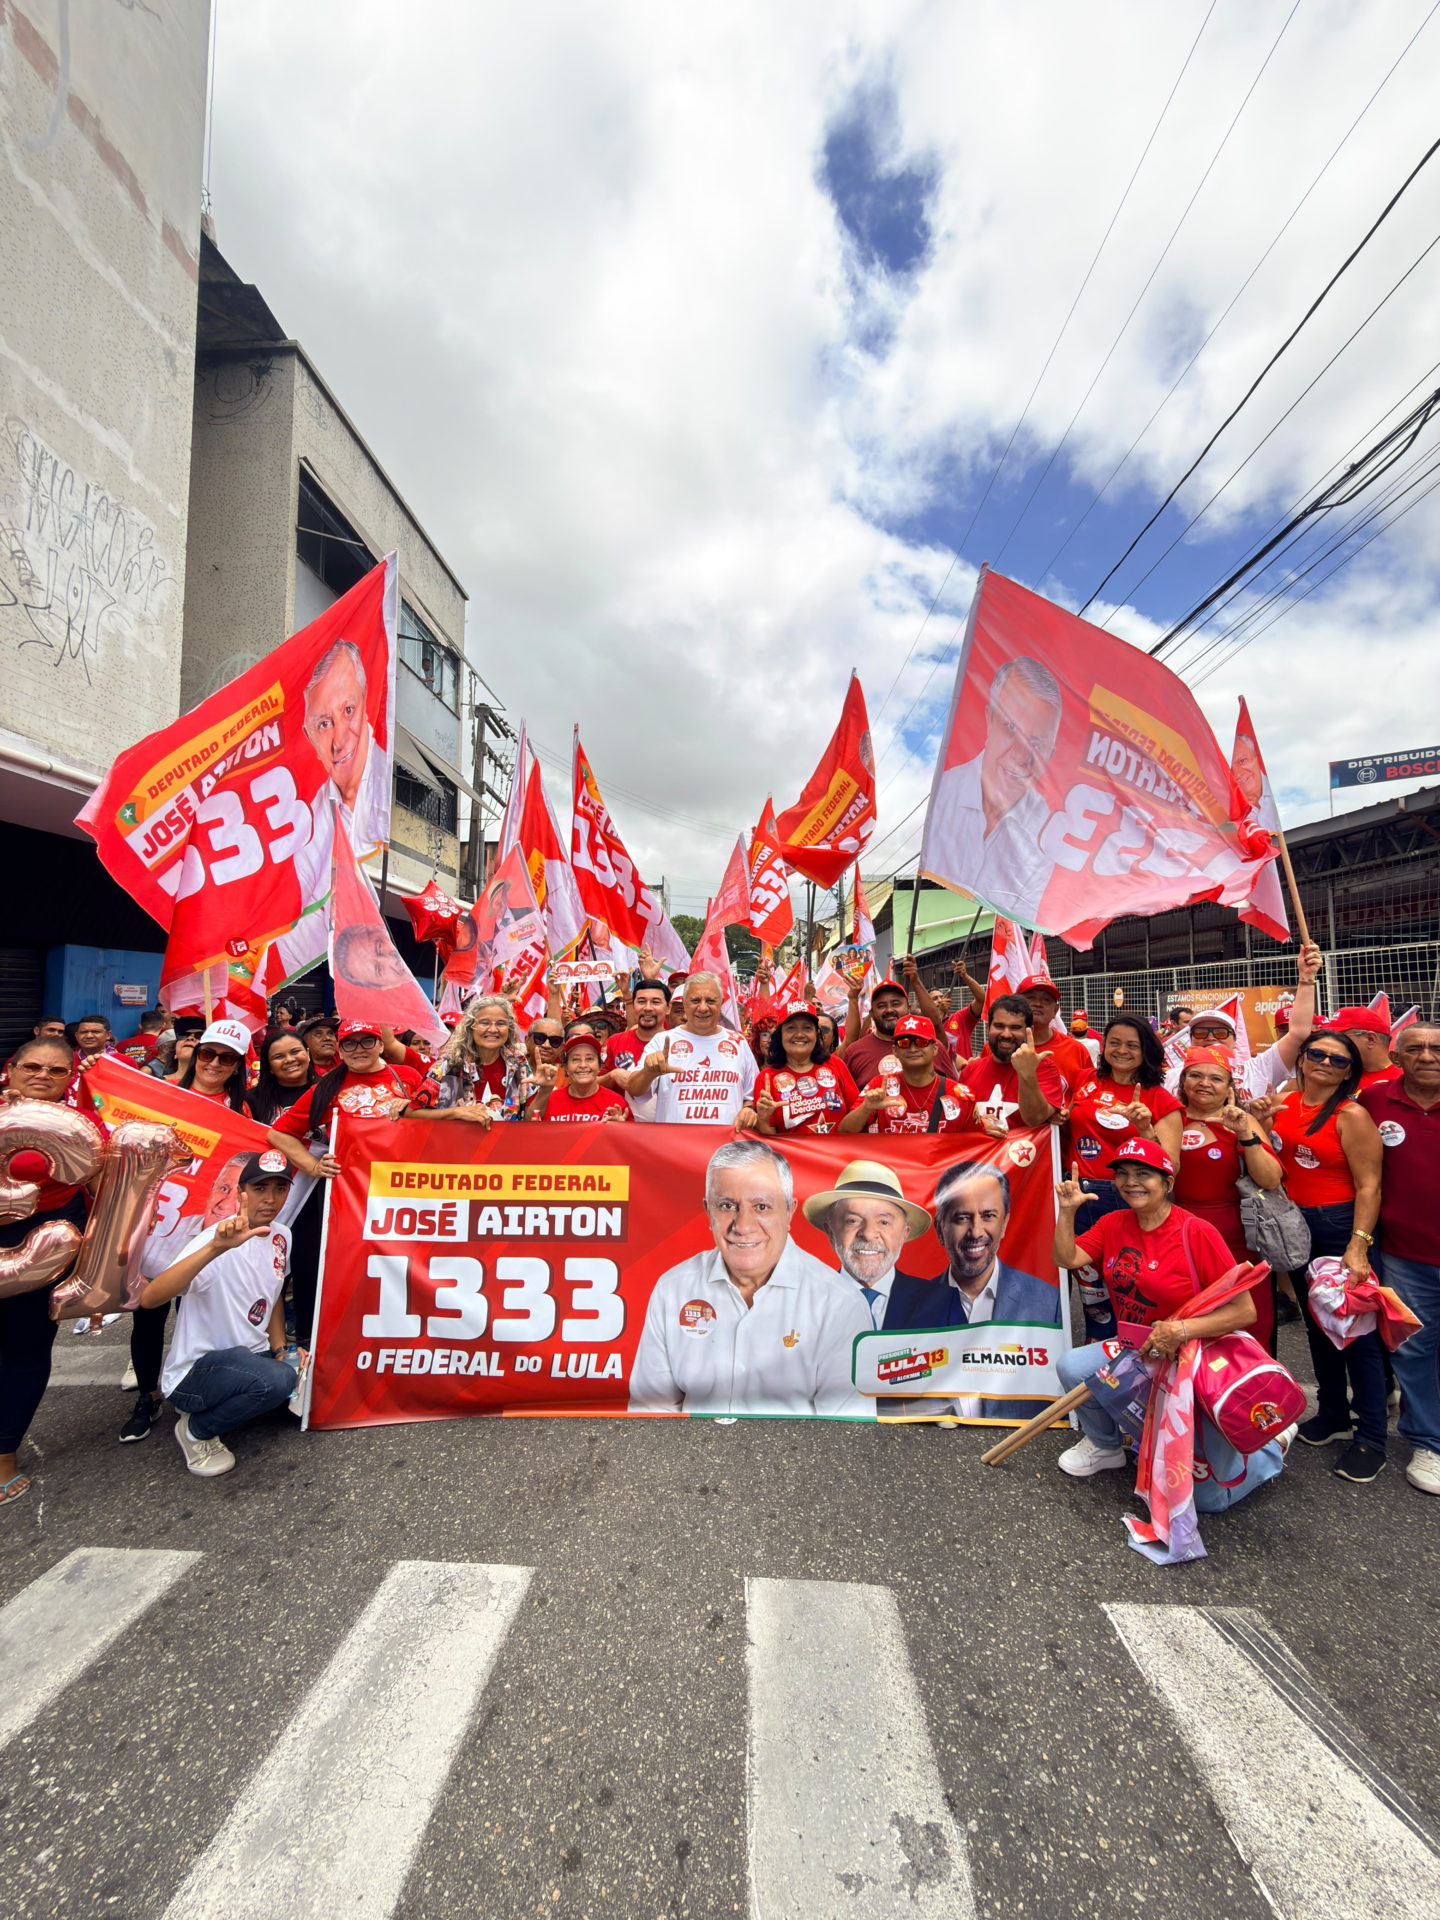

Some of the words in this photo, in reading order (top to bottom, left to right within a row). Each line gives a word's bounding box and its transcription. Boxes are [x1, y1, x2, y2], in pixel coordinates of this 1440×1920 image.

[147, 741, 219, 800] DEPUTADO
[222, 695, 279, 744] FEDERAL
[822, 780, 851, 820] FEDERAL
[142, 793, 196, 859] JOSÉ
[1167, 994, 1194, 1003] ESTAMOS
[216, 1026, 241, 1041] LULA
[671, 1068, 700, 1083] JOSÉ
[701, 1070, 739, 1083] AIRTON
[678, 1088, 729, 1101] ELMANO
[1100, 1092, 1114, 1102] 13
[685, 1107, 719, 1119] LULA
[1182, 1134, 1201, 1145] 13
[1119, 1146, 1145, 1156] LULA
[390, 1171, 502, 1190] DEPUTADO
[512, 1175, 611, 1191] FEDERAL
[370, 1202, 457, 1236] JOSÉ
[477, 1206, 622, 1236] AIRTON
[362, 1255, 627, 1342] 1333
[1124, 1301, 1147, 1317] COM
[878, 1348, 910, 1361] PRESIDENTE
[879, 1353, 927, 1375] LULA
[930, 1348, 944, 1363] 13
[356, 1351, 372, 1370] O
[376, 1349, 505, 1377] FEDERAL
[514, 1356, 542, 1373] DO
[550, 1353, 623, 1379] LULA
[897, 1372, 921, 1382] ALCKMIN
